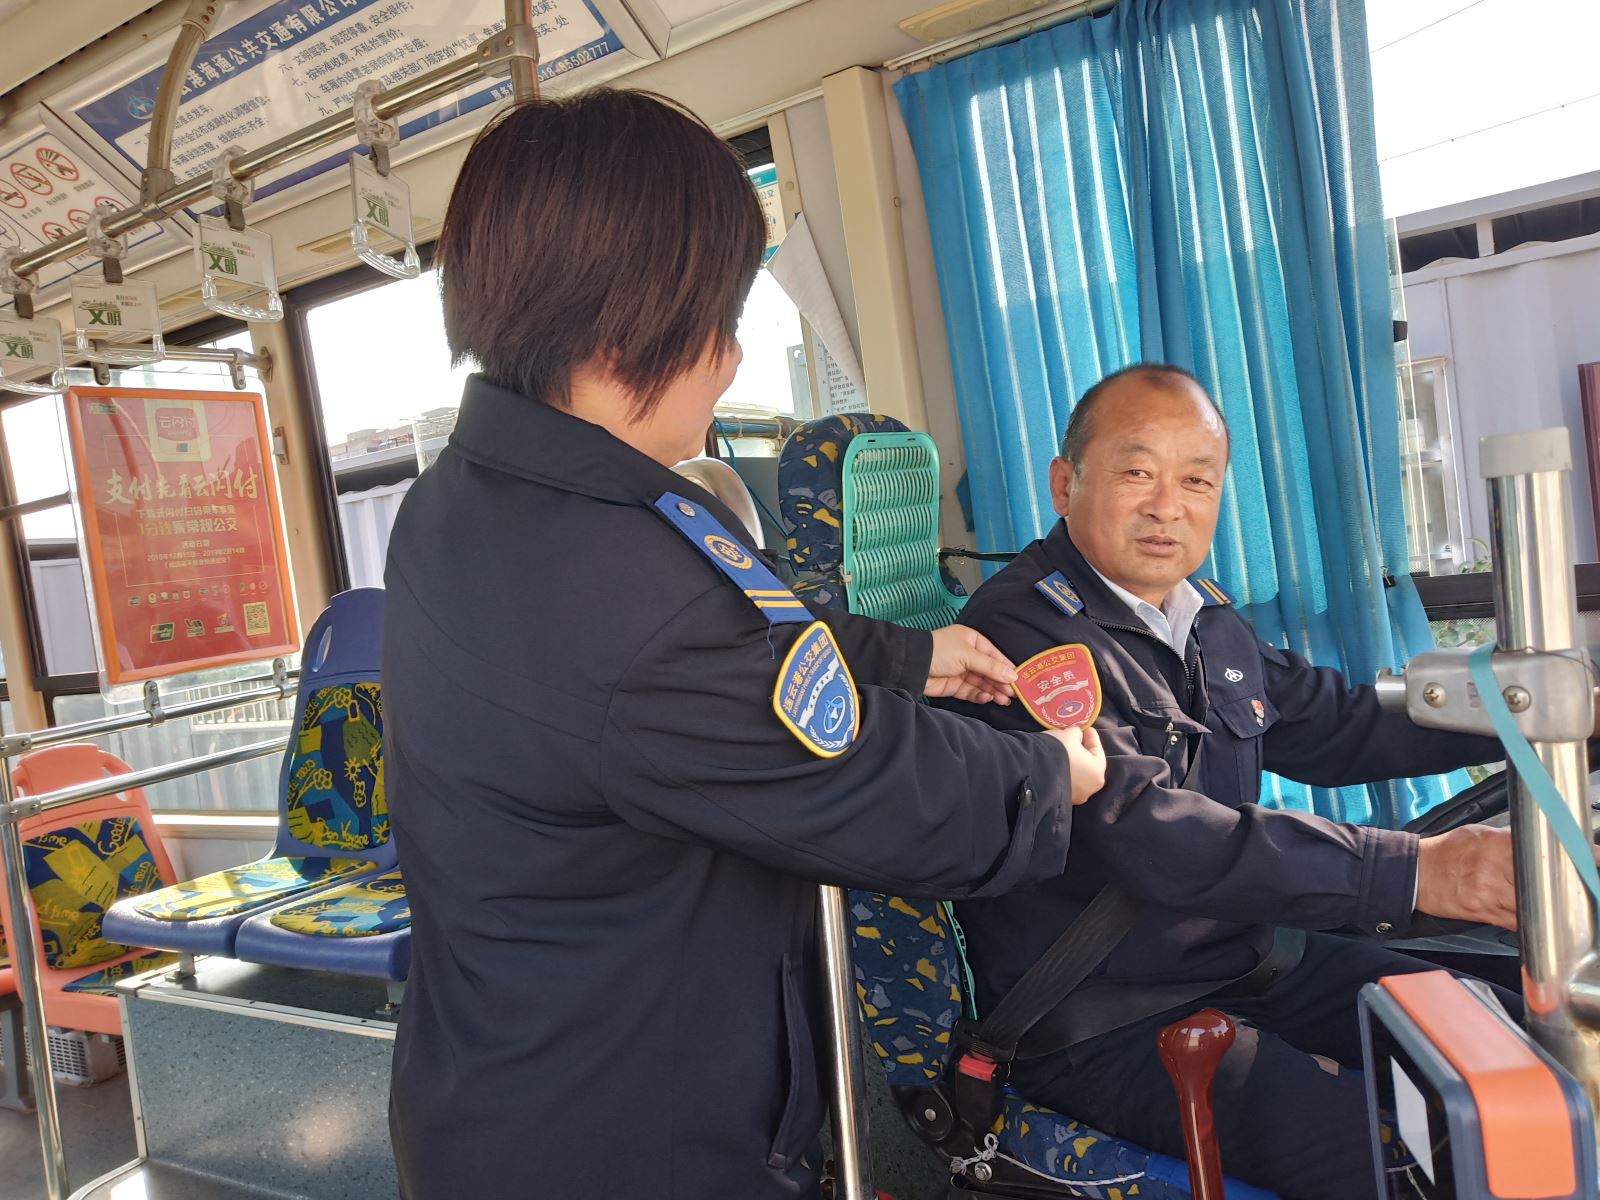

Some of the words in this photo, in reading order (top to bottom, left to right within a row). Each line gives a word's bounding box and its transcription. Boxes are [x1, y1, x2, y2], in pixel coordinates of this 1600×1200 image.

[182, 0, 358, 96] 港海通公共交通有限公
[1037, 670, 1076, 692] 安全员
